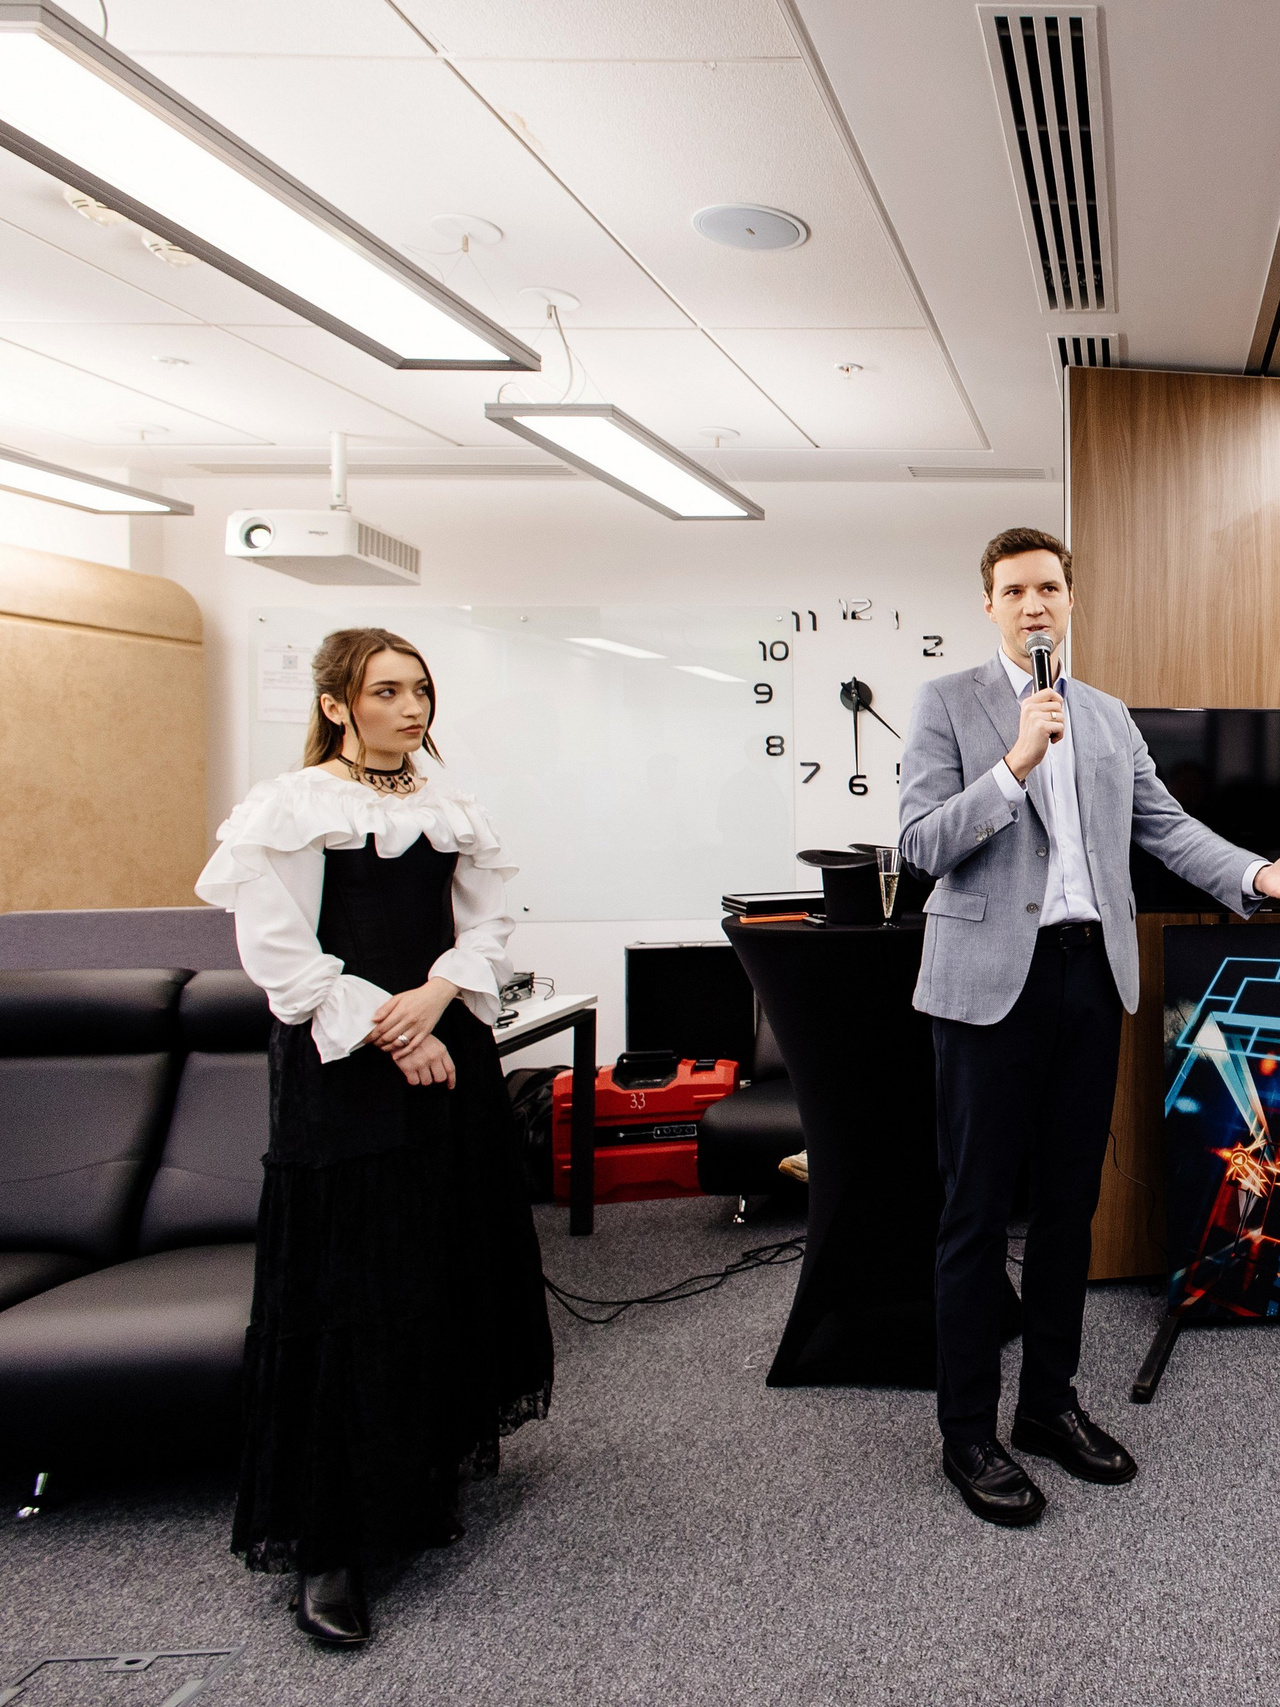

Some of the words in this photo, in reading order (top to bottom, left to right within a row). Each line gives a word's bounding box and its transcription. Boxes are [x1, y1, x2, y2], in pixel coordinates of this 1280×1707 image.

[838, 598, 872, 620] 12
[791, 610, 817, 632] 11
[758, 640, 789, 661] 10
[923, 635, 944, 657] 2
[753, 683, 773, 704] 9
[765, 735, 785, 756] 8
[800, 762, 821, 784] 7
[848, 774, 868, 796] 6
